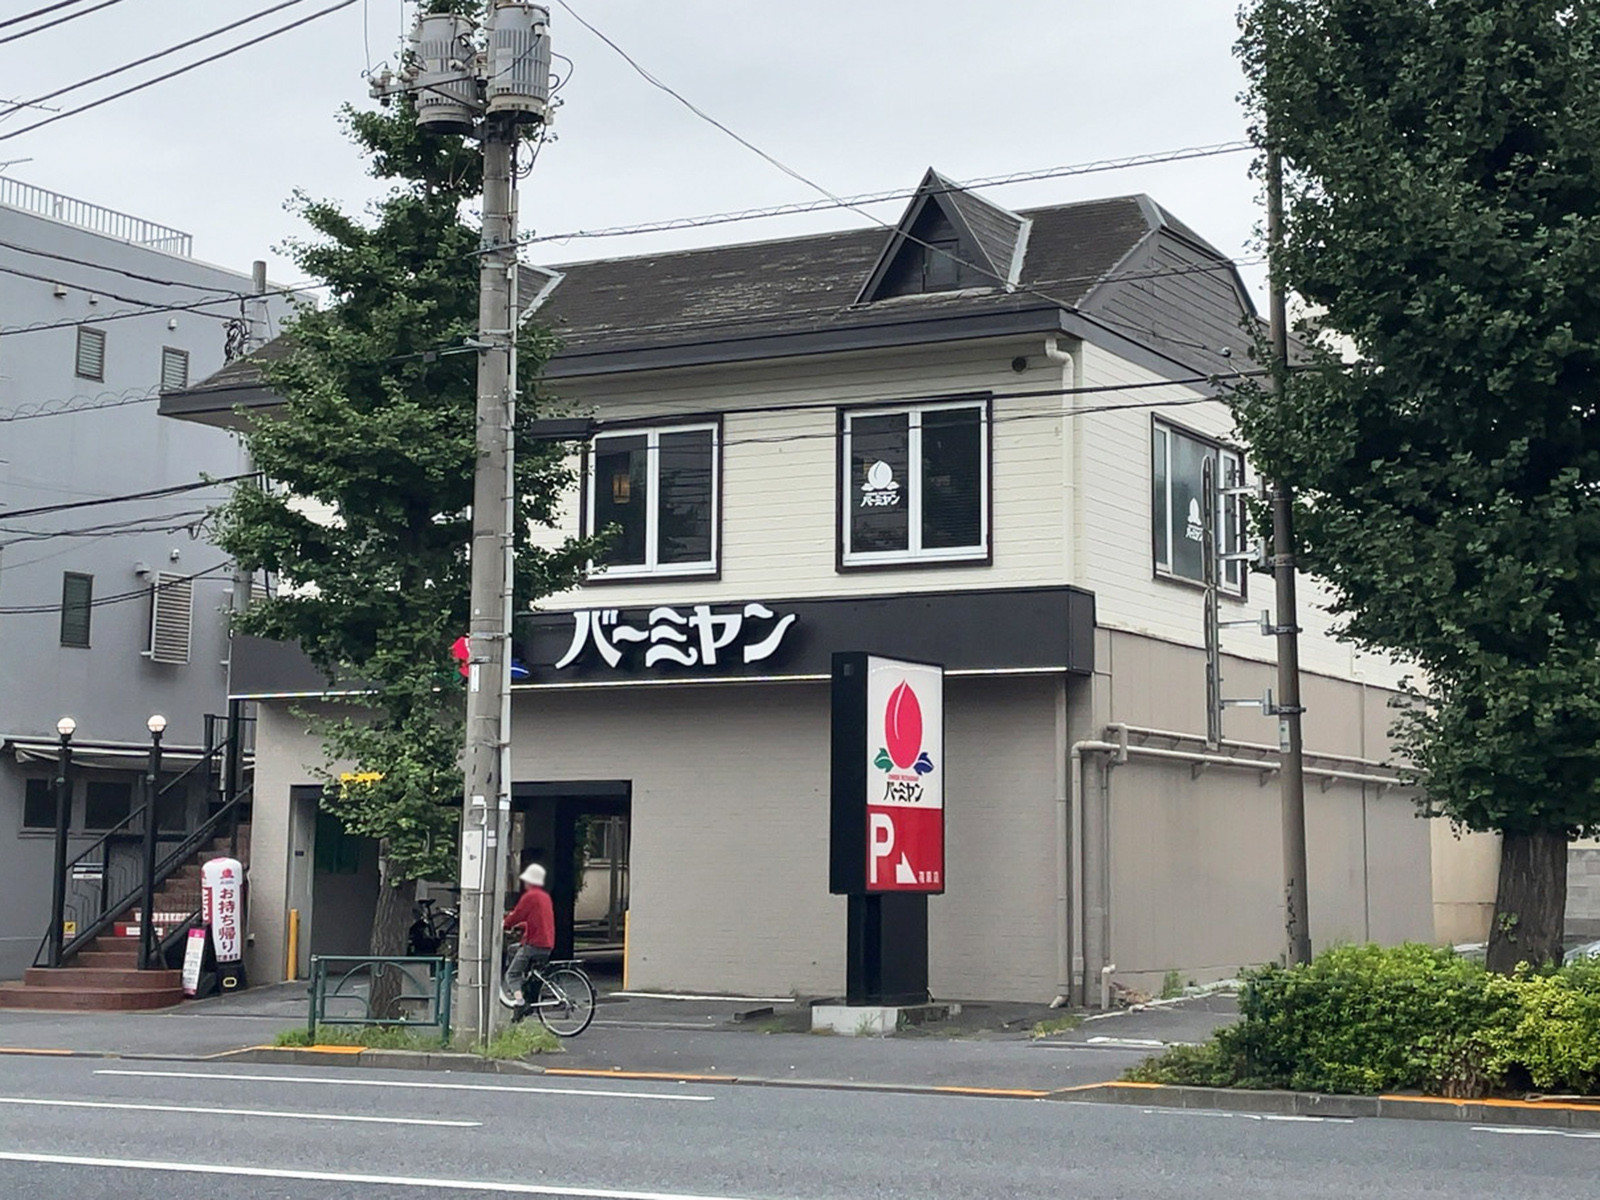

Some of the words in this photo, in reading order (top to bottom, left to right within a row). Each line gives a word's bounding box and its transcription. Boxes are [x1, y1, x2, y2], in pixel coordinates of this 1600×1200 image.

[555, 603, 796, 669] バーミヤン
[883, 781, 924, 803] バーミヤン
[869, 813, 895, 883] P
[218, 888, 236, 953] お持ち帰り
